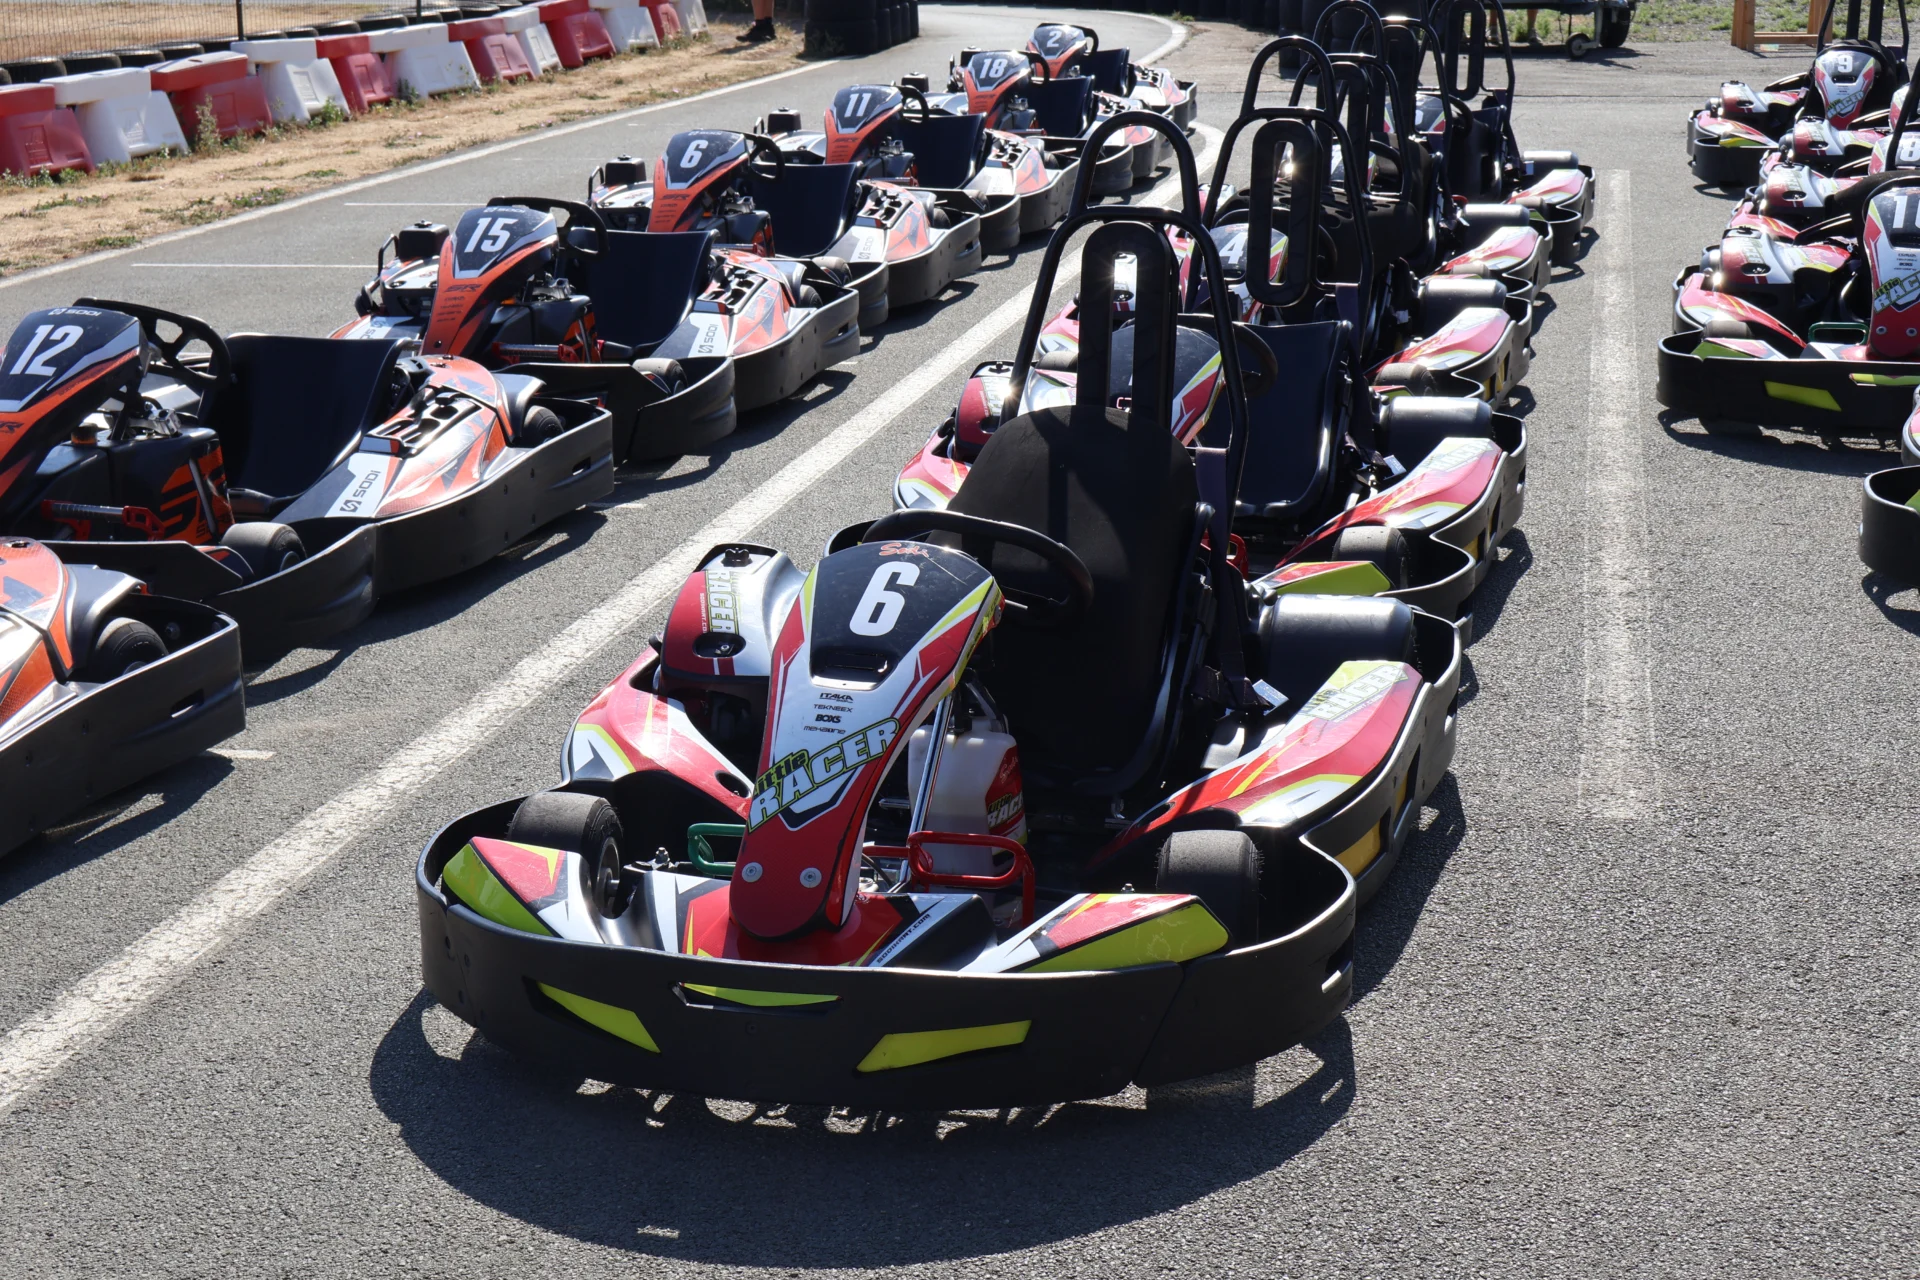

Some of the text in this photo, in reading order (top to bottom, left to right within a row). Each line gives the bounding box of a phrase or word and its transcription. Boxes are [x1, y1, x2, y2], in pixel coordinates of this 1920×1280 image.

[1046, 30, 1063, 48] 2
[979, 58, 1008, 79] 18
[1837, 54, 1854, 73] 9
[844, 92, 872, 118] 11
[679, 139, 709, 169] 6
[464, 216, 519, 253] 15
[1219, 230, 1248, 264] 4
[9, 324, 84, 377] 12
[849, 560, 920, 637] 6
[815, 713, 842, 724] BOXS
[748, 717, 901, 833] RACER
